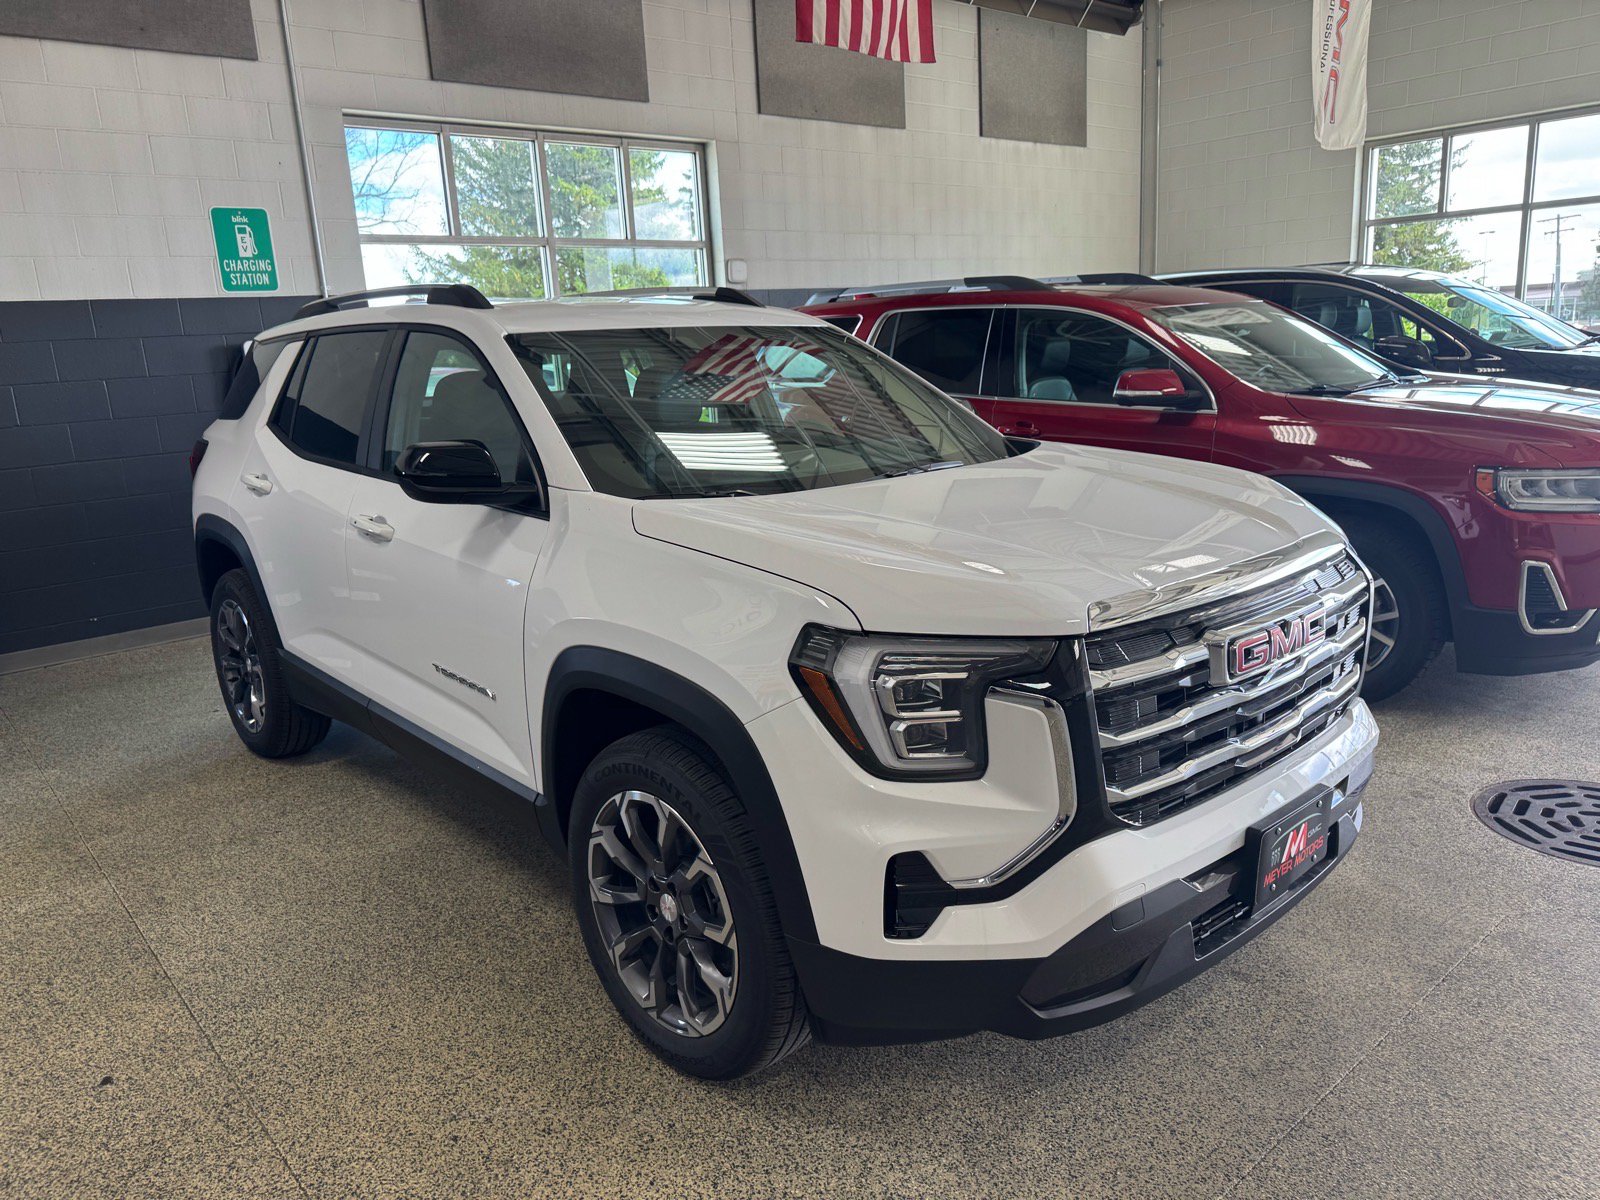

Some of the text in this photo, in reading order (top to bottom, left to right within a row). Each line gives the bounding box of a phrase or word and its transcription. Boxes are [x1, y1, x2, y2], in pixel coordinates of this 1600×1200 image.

[1320, 0, 1336, 73] OFESSIONA
[231, 215, 249, 223] blink
[223, 259, 272, 272] CHARGING
[230, 273, 270, 285] STATION
[1236, 608, 1327, 674] GMC
[1263, 836, 1324, 888] MEYER MOTORS
